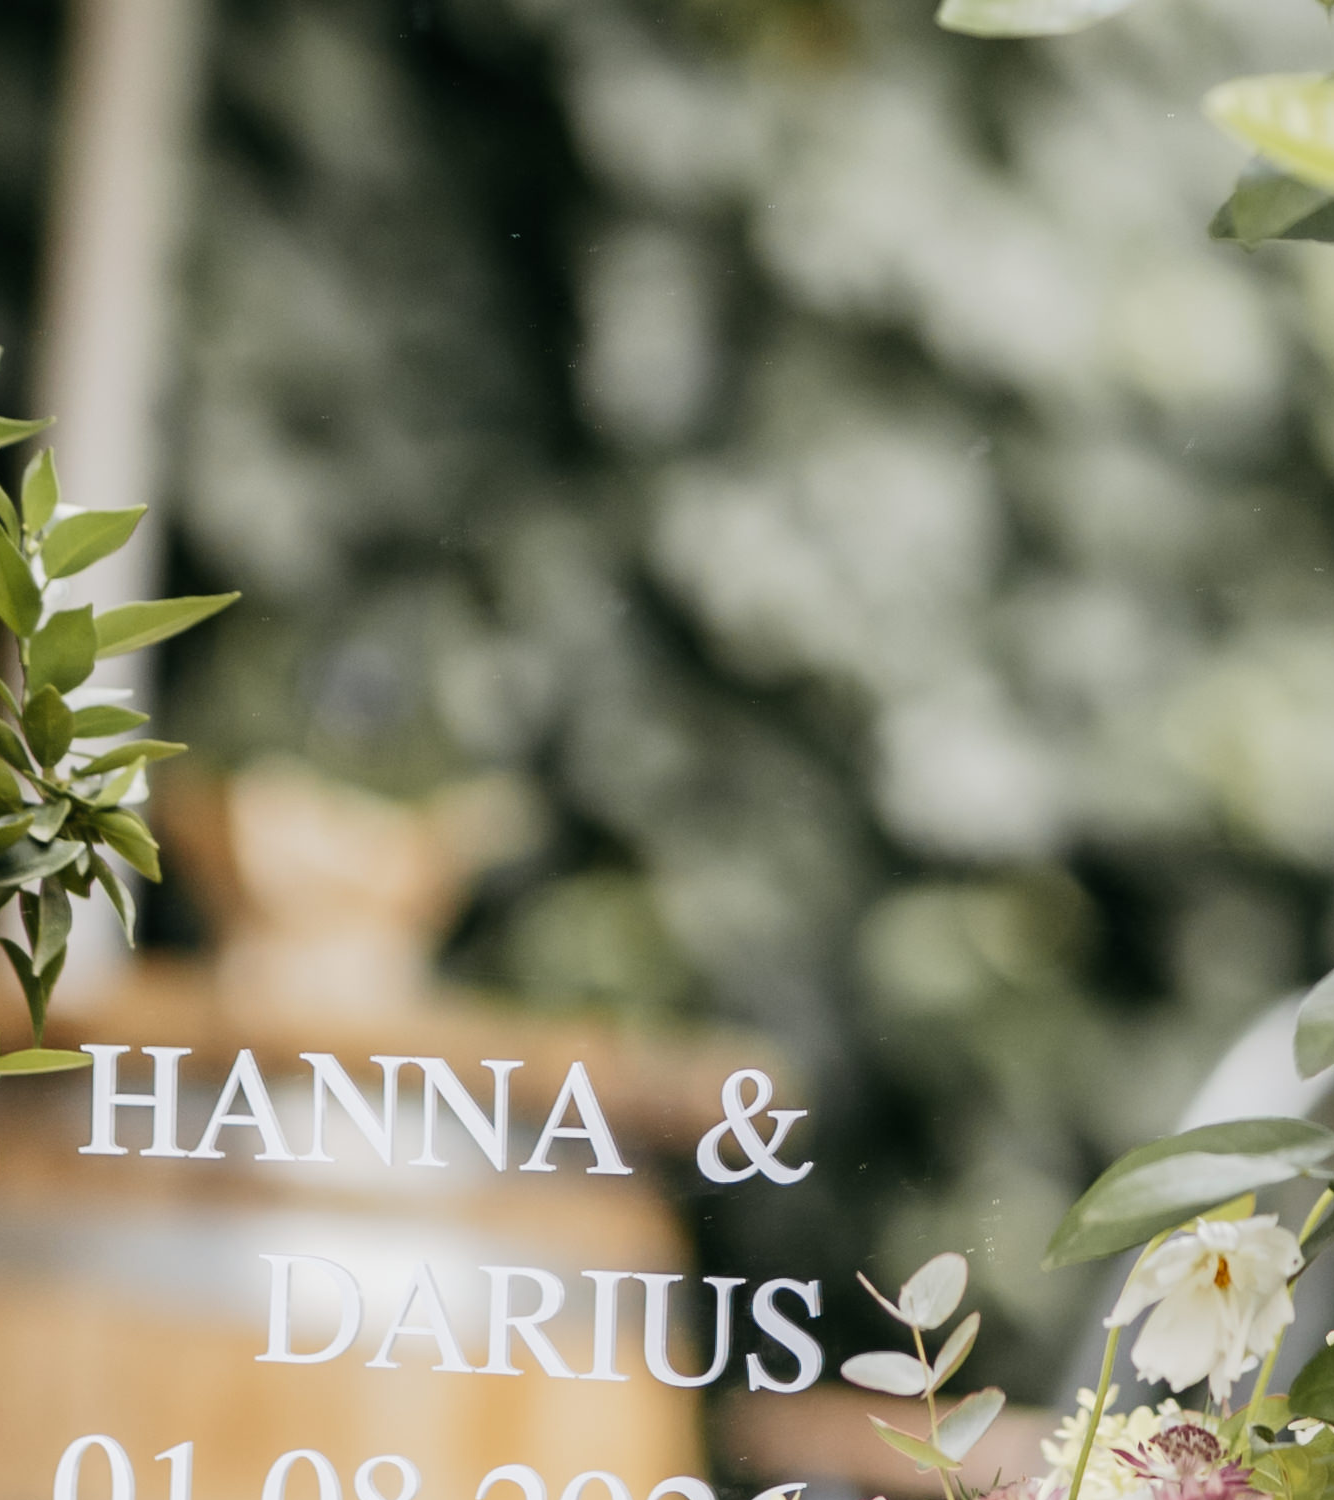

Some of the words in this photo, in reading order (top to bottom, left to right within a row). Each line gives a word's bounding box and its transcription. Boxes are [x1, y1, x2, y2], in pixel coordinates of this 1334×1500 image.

[78, 1042, 634, 1177] HANNA
[696, 1068, 815, 1186] &
[253, 1252, 825, 1395] DARIUS
